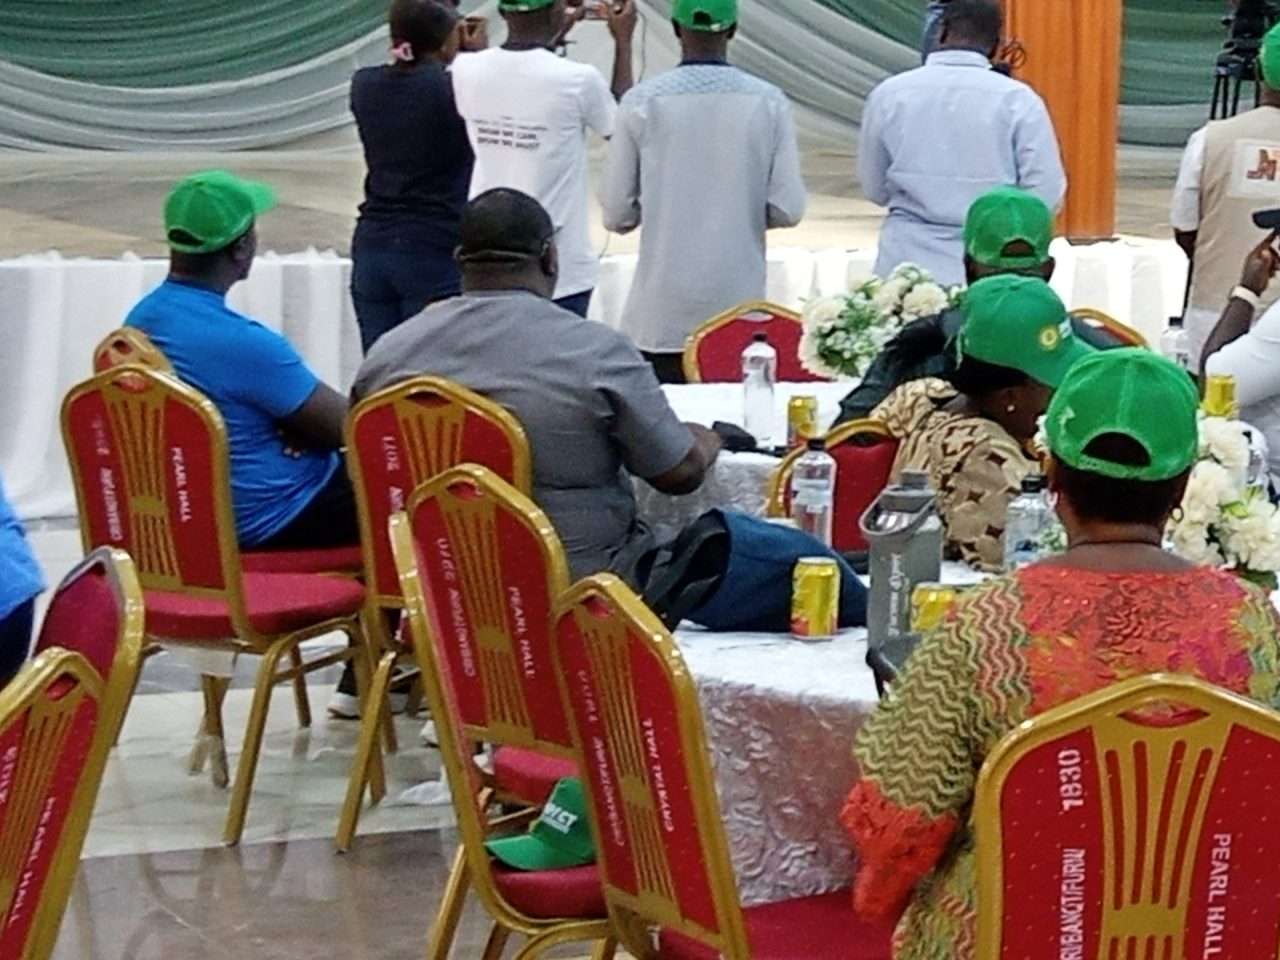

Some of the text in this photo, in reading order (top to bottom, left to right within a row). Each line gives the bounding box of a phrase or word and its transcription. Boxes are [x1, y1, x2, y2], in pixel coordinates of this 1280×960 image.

[171, 446, 192, 523] PEARL HALL
[508, 586, 535, 680] PEARL HALL
[1057, 748, 1084, 812] 1830
[1204, 833, 1231, 959] PEARL HALL
